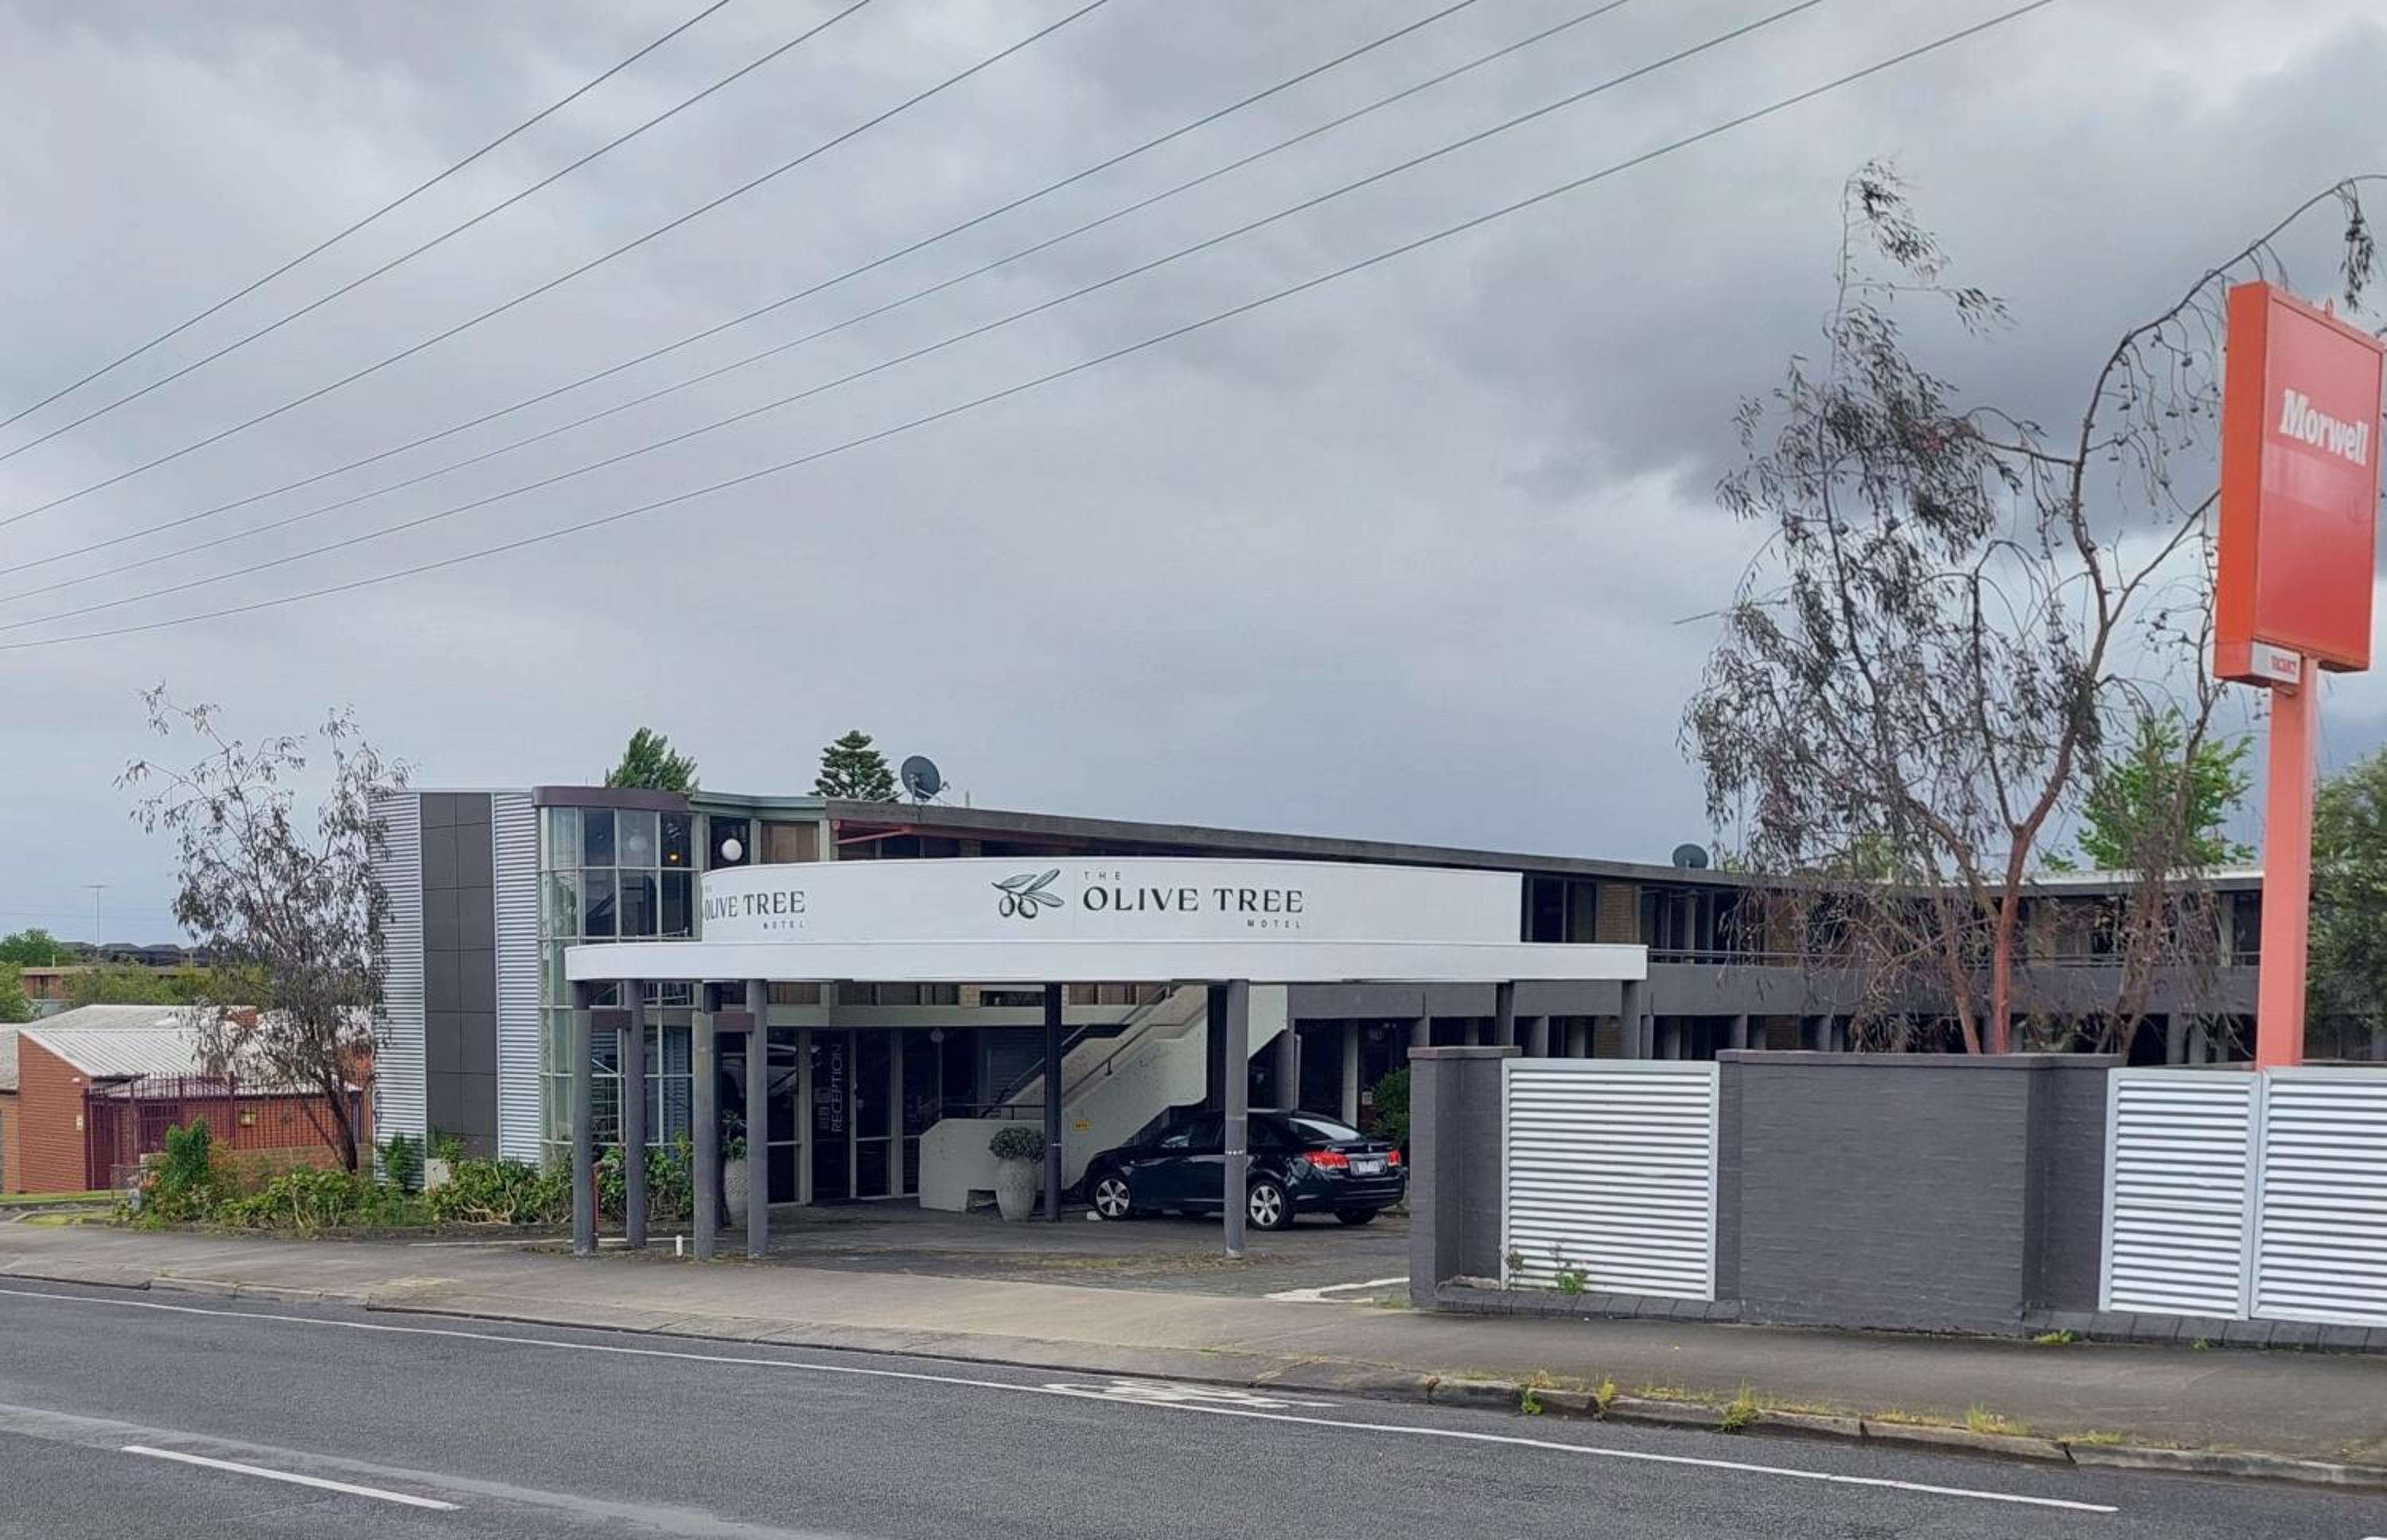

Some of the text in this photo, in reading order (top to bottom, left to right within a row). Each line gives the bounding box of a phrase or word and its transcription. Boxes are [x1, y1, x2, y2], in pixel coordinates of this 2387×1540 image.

[2279, 387, 2369, 467] Morwell
[1084, 871, 1121, 881] THE
[704, 890, 806, 922] OLIVE TREE
[1083, 885, 1303, 913] OLIVE TREE
[1247, 919, 1301, 929] MOTEL
[831, 1043, 843, 1132] RECEPTION
